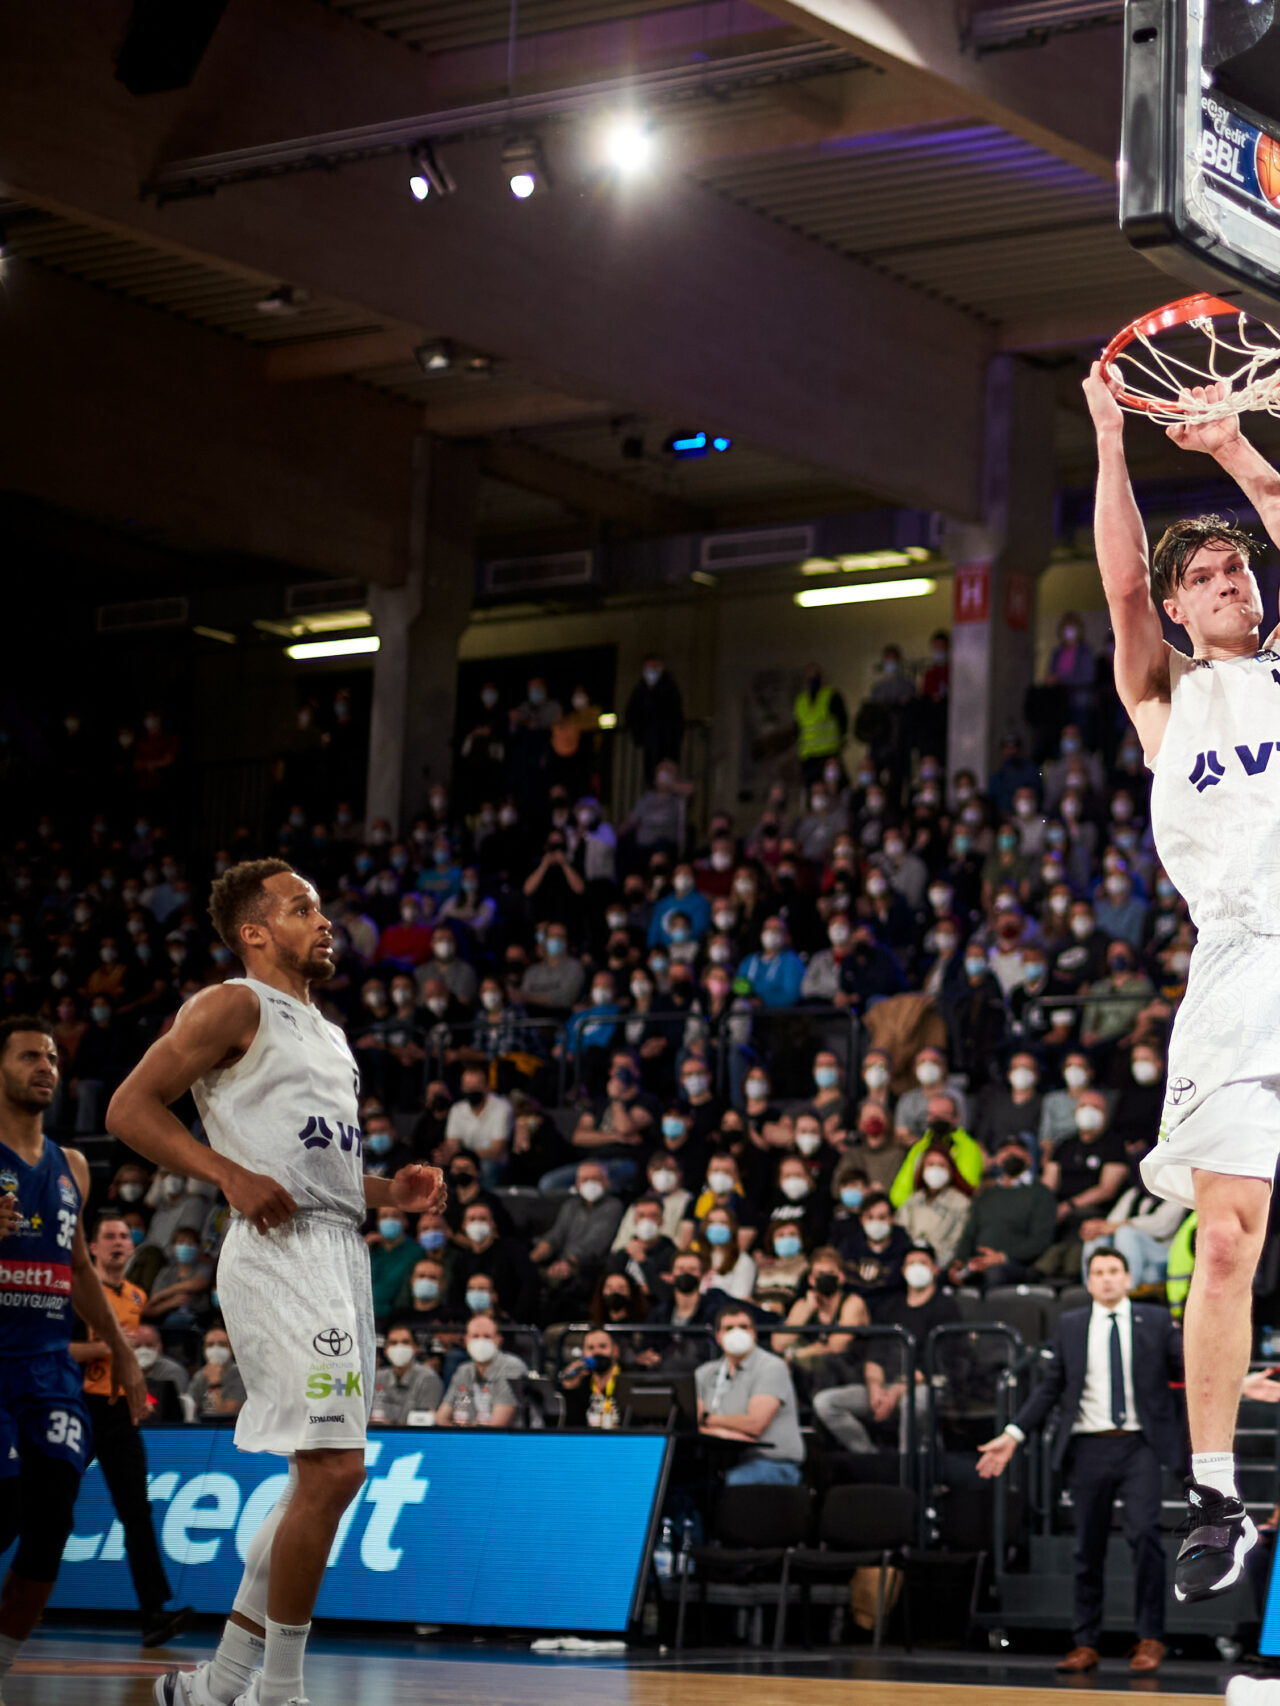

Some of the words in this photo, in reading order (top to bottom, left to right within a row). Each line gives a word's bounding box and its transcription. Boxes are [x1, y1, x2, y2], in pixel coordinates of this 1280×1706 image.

[1213, 117, 1247, 148] Credit
[1202, 129, 1245, 183] BBL
[961, 579, 982, 608] H
[305, 1371, 361, 1400] S+K
[46, 1411, 82, 1453] 32
[309, 1415, 345, 1424] SPALDING
[62, 1441, 430, 1572] reit
